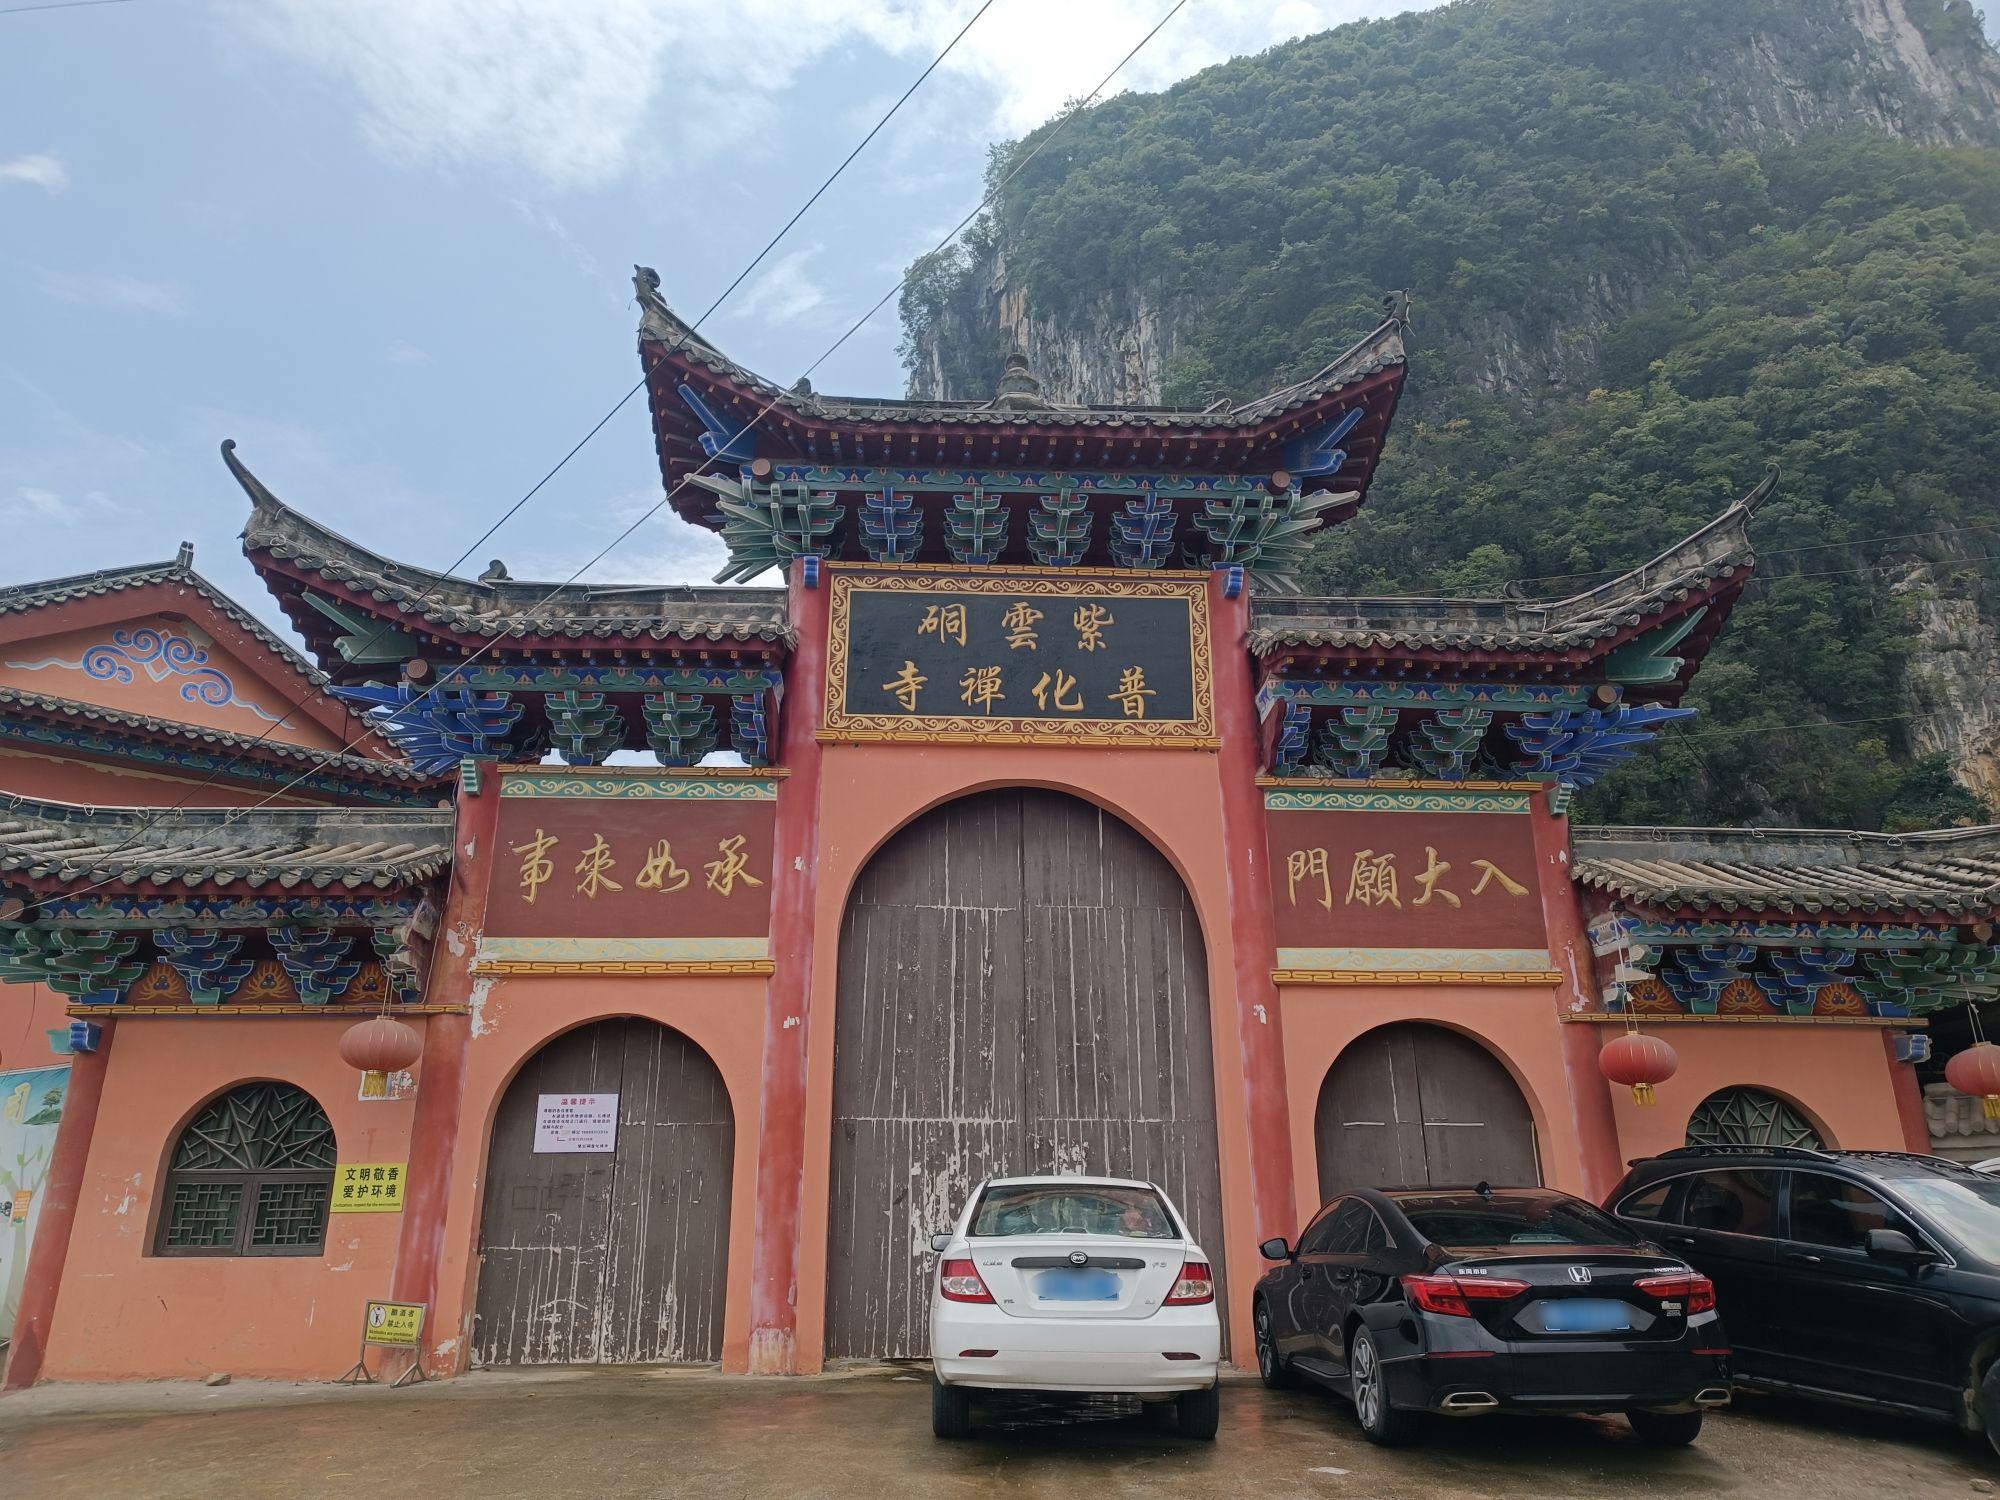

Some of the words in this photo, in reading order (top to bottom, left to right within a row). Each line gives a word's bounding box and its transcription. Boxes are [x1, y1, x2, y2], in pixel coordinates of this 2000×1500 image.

[344, 1167, 399, 1181] 文明敬香
[343, 1184, 397, 1198] 爱护环境
